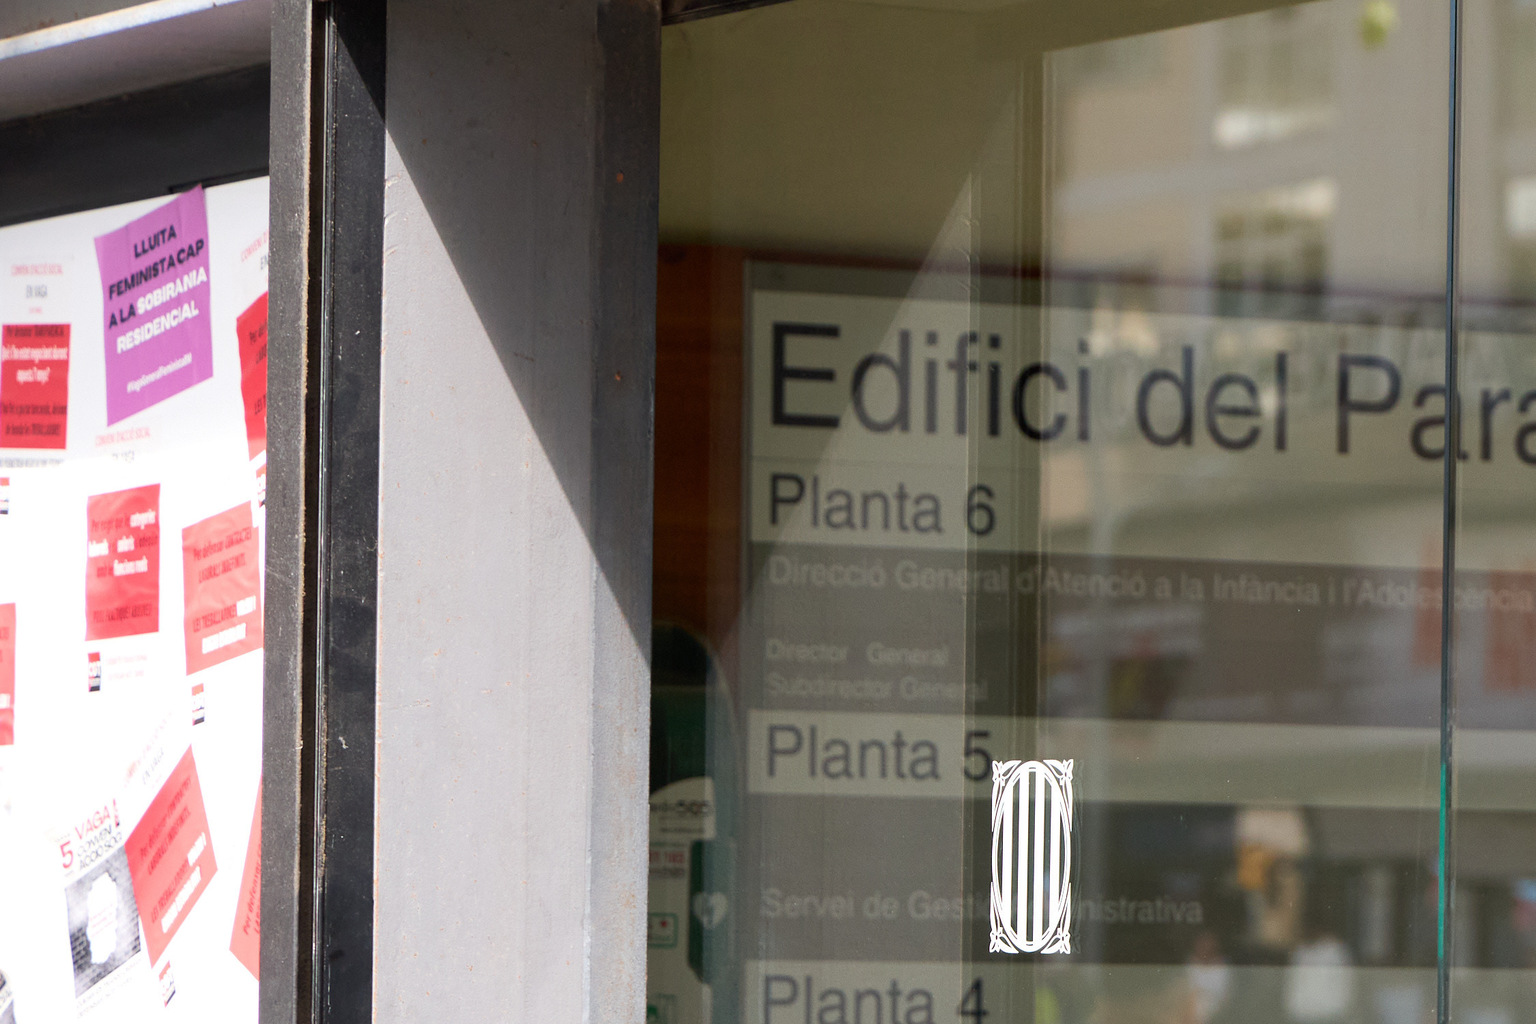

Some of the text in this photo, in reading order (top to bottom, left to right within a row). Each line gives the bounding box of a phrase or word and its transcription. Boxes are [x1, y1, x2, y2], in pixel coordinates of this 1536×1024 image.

[109, 239, 205, 301] FEMINISTA CAP
[134, 225, 177, 259] LLUITA
[109, 266, 208, 329] A LA SOBIRANIA
[117, 300, 200, 354] RESIDENCIAL
[770, 320, 1093, 442] Edifici
[1135, 345, 1290, 453] del
[767, 473, 996, 536] Planta 6
[768, 553, 888, 588] Direcció
[895, 559, 1010, 592] General
[1015, 565, 1147, 599] d'Atenció
[1154, 576, 1172, 599] a
[1180, 571, 1205, 601] la
[1212, 570, 1320, 605] Infància
[767, 723, 993, 781] Planta 5
[60, 840, 74, 870] 5
[759, 886, 856, 920] Servei
[862, 886, 900, 920] de
